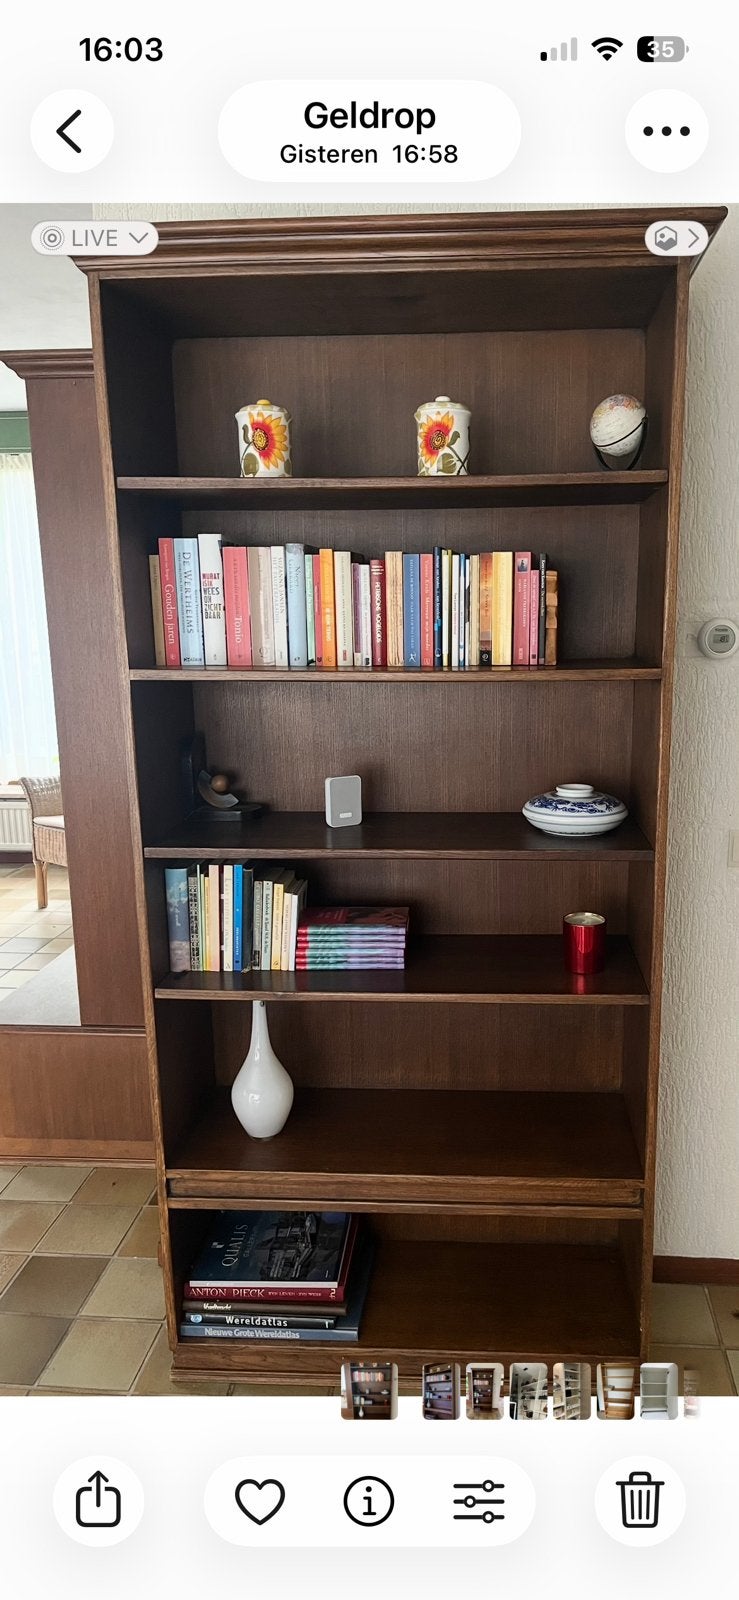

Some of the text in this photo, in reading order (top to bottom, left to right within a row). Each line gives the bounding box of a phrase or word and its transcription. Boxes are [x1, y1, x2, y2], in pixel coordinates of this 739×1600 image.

[182, 552, 194, 634] DE WERTHEIMS
[203, 587, 220, 595] WEES
[204, 603, 222, 611] ZICHT
[164, 584, 176, 644] Gouden jaren
[205, 611, 221, 619] BAAR
[234, 616, 243, 643] Tonio
[222, 1225, 248, 1267] QUALIS
[190, 1288, 227, 1297] ANTON
[232, 1288, 265, 1298] PIECK
[226, 1316, 288, 1327] Wereldatlas
[204, 1327, 300, 1339] Nieuwe Grote Wereldatlas
